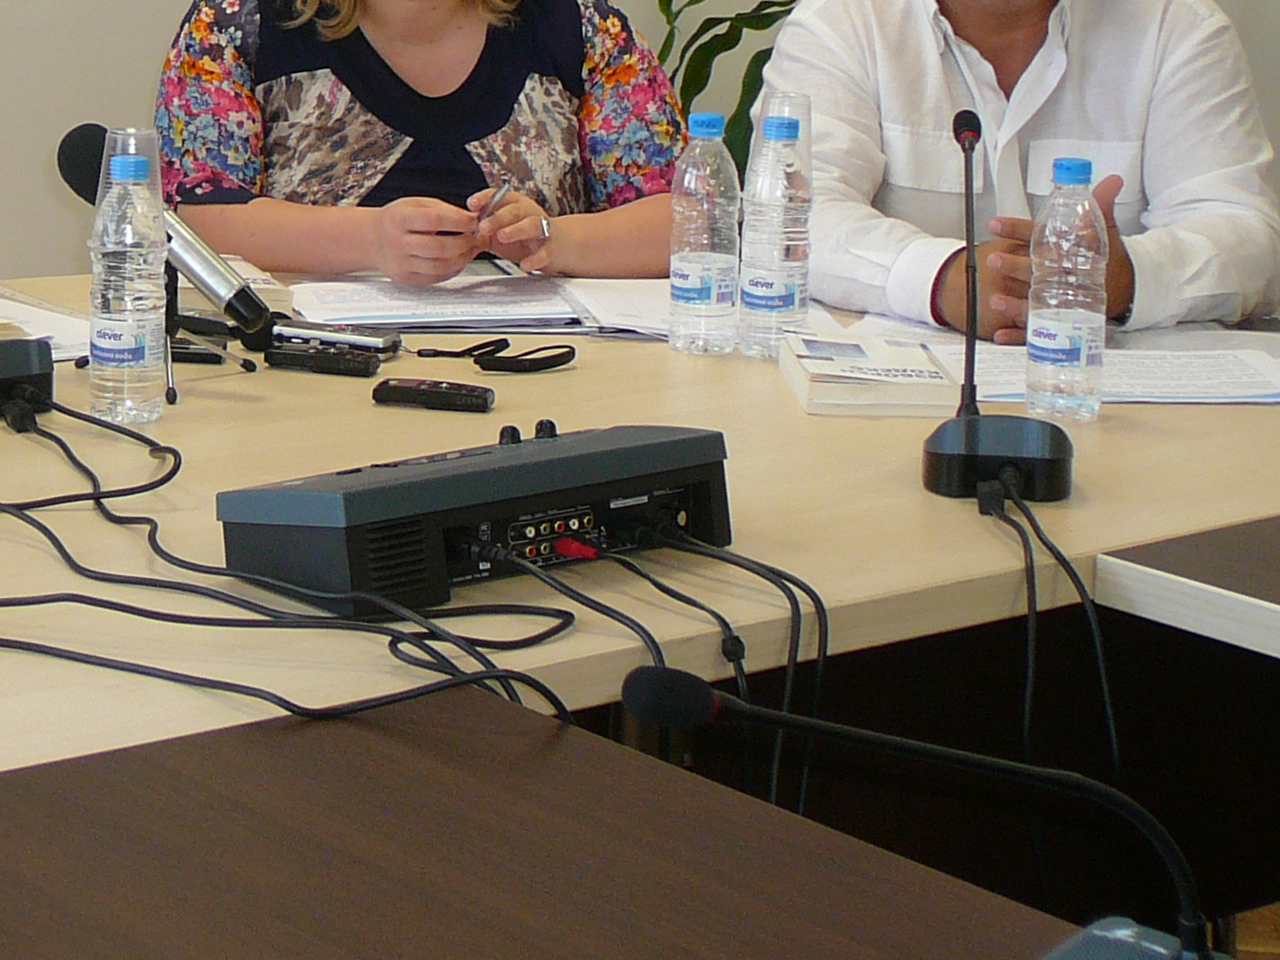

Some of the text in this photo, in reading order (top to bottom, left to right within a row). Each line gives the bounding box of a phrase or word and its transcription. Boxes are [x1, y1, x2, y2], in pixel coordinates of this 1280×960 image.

[748, 278, 775, 289] clever
[96, 328, 123, 341] clever
[1032, 328, 1058, 341] clever
